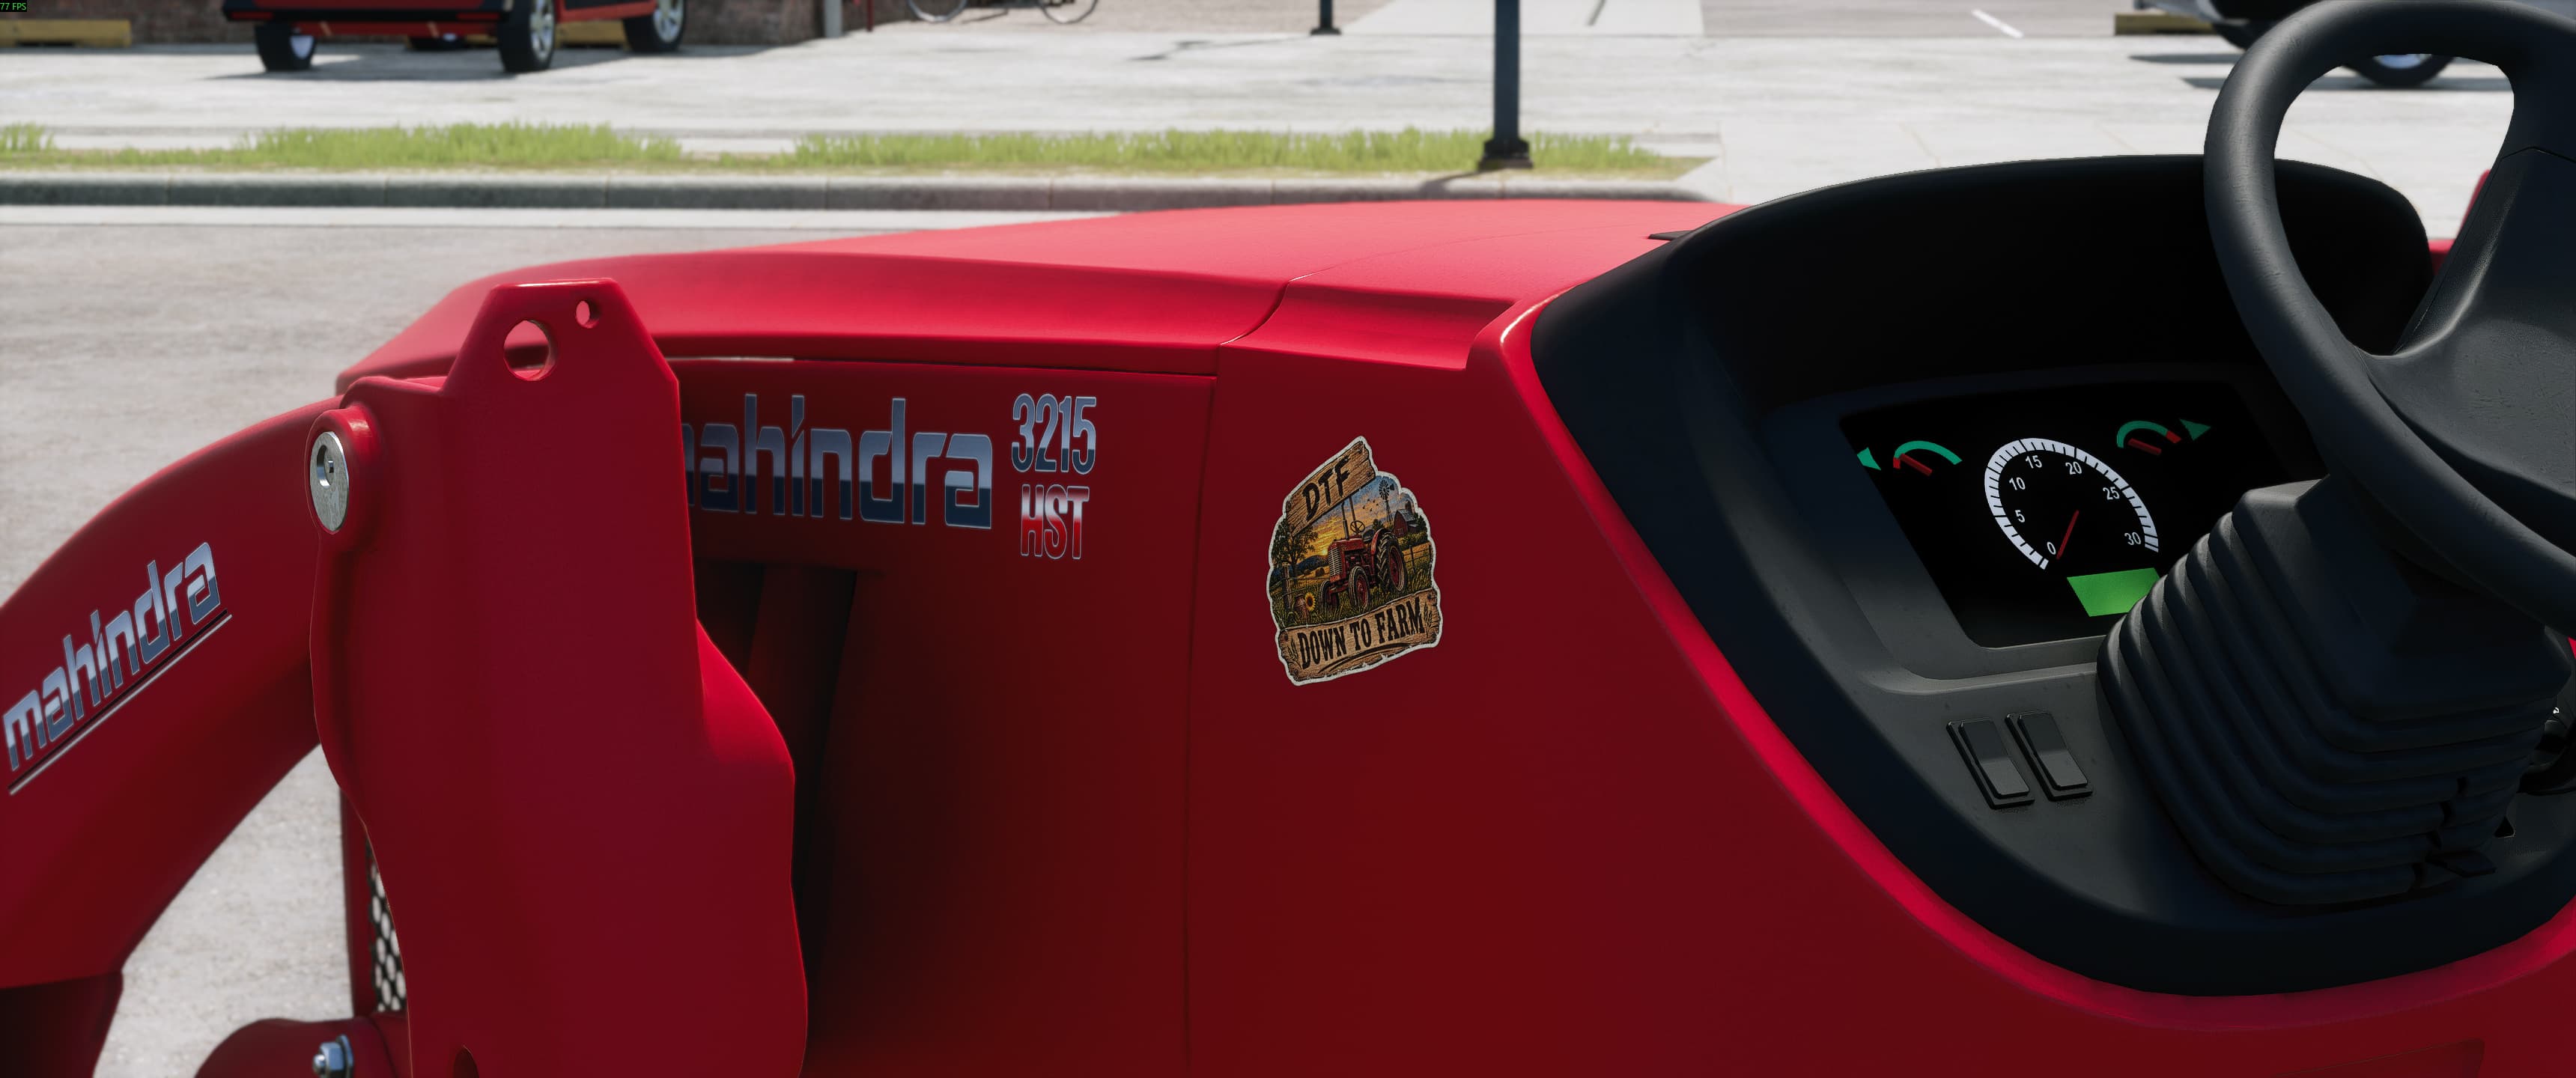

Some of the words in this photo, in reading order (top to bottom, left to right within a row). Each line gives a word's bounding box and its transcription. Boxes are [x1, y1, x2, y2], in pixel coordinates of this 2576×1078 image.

[1011, 393, 1097, 475] 3215
[681, 393, 993, 530] ahindra
[2026, 455, 2043, 470] 15
[2065, 461, 2083, 475] 20
[1301, 454, 1352, 522] DTF
[2009, 477, 2026, 491] 10
[2102, 487, 2120, 501] 25
[1020, 484, 1090, 559] HST
[2015, 509, 2026, 524] 5
[2124, 532, 2142, 546] 30
[2046, 541, 2056, 555] 0
[1297, 625, 1347, 669] DOWN
[1350, 620, 1372, 653] TO
[1375, 597, 1426, 645] FARM
[3, 541, 221, 772] mahindra
